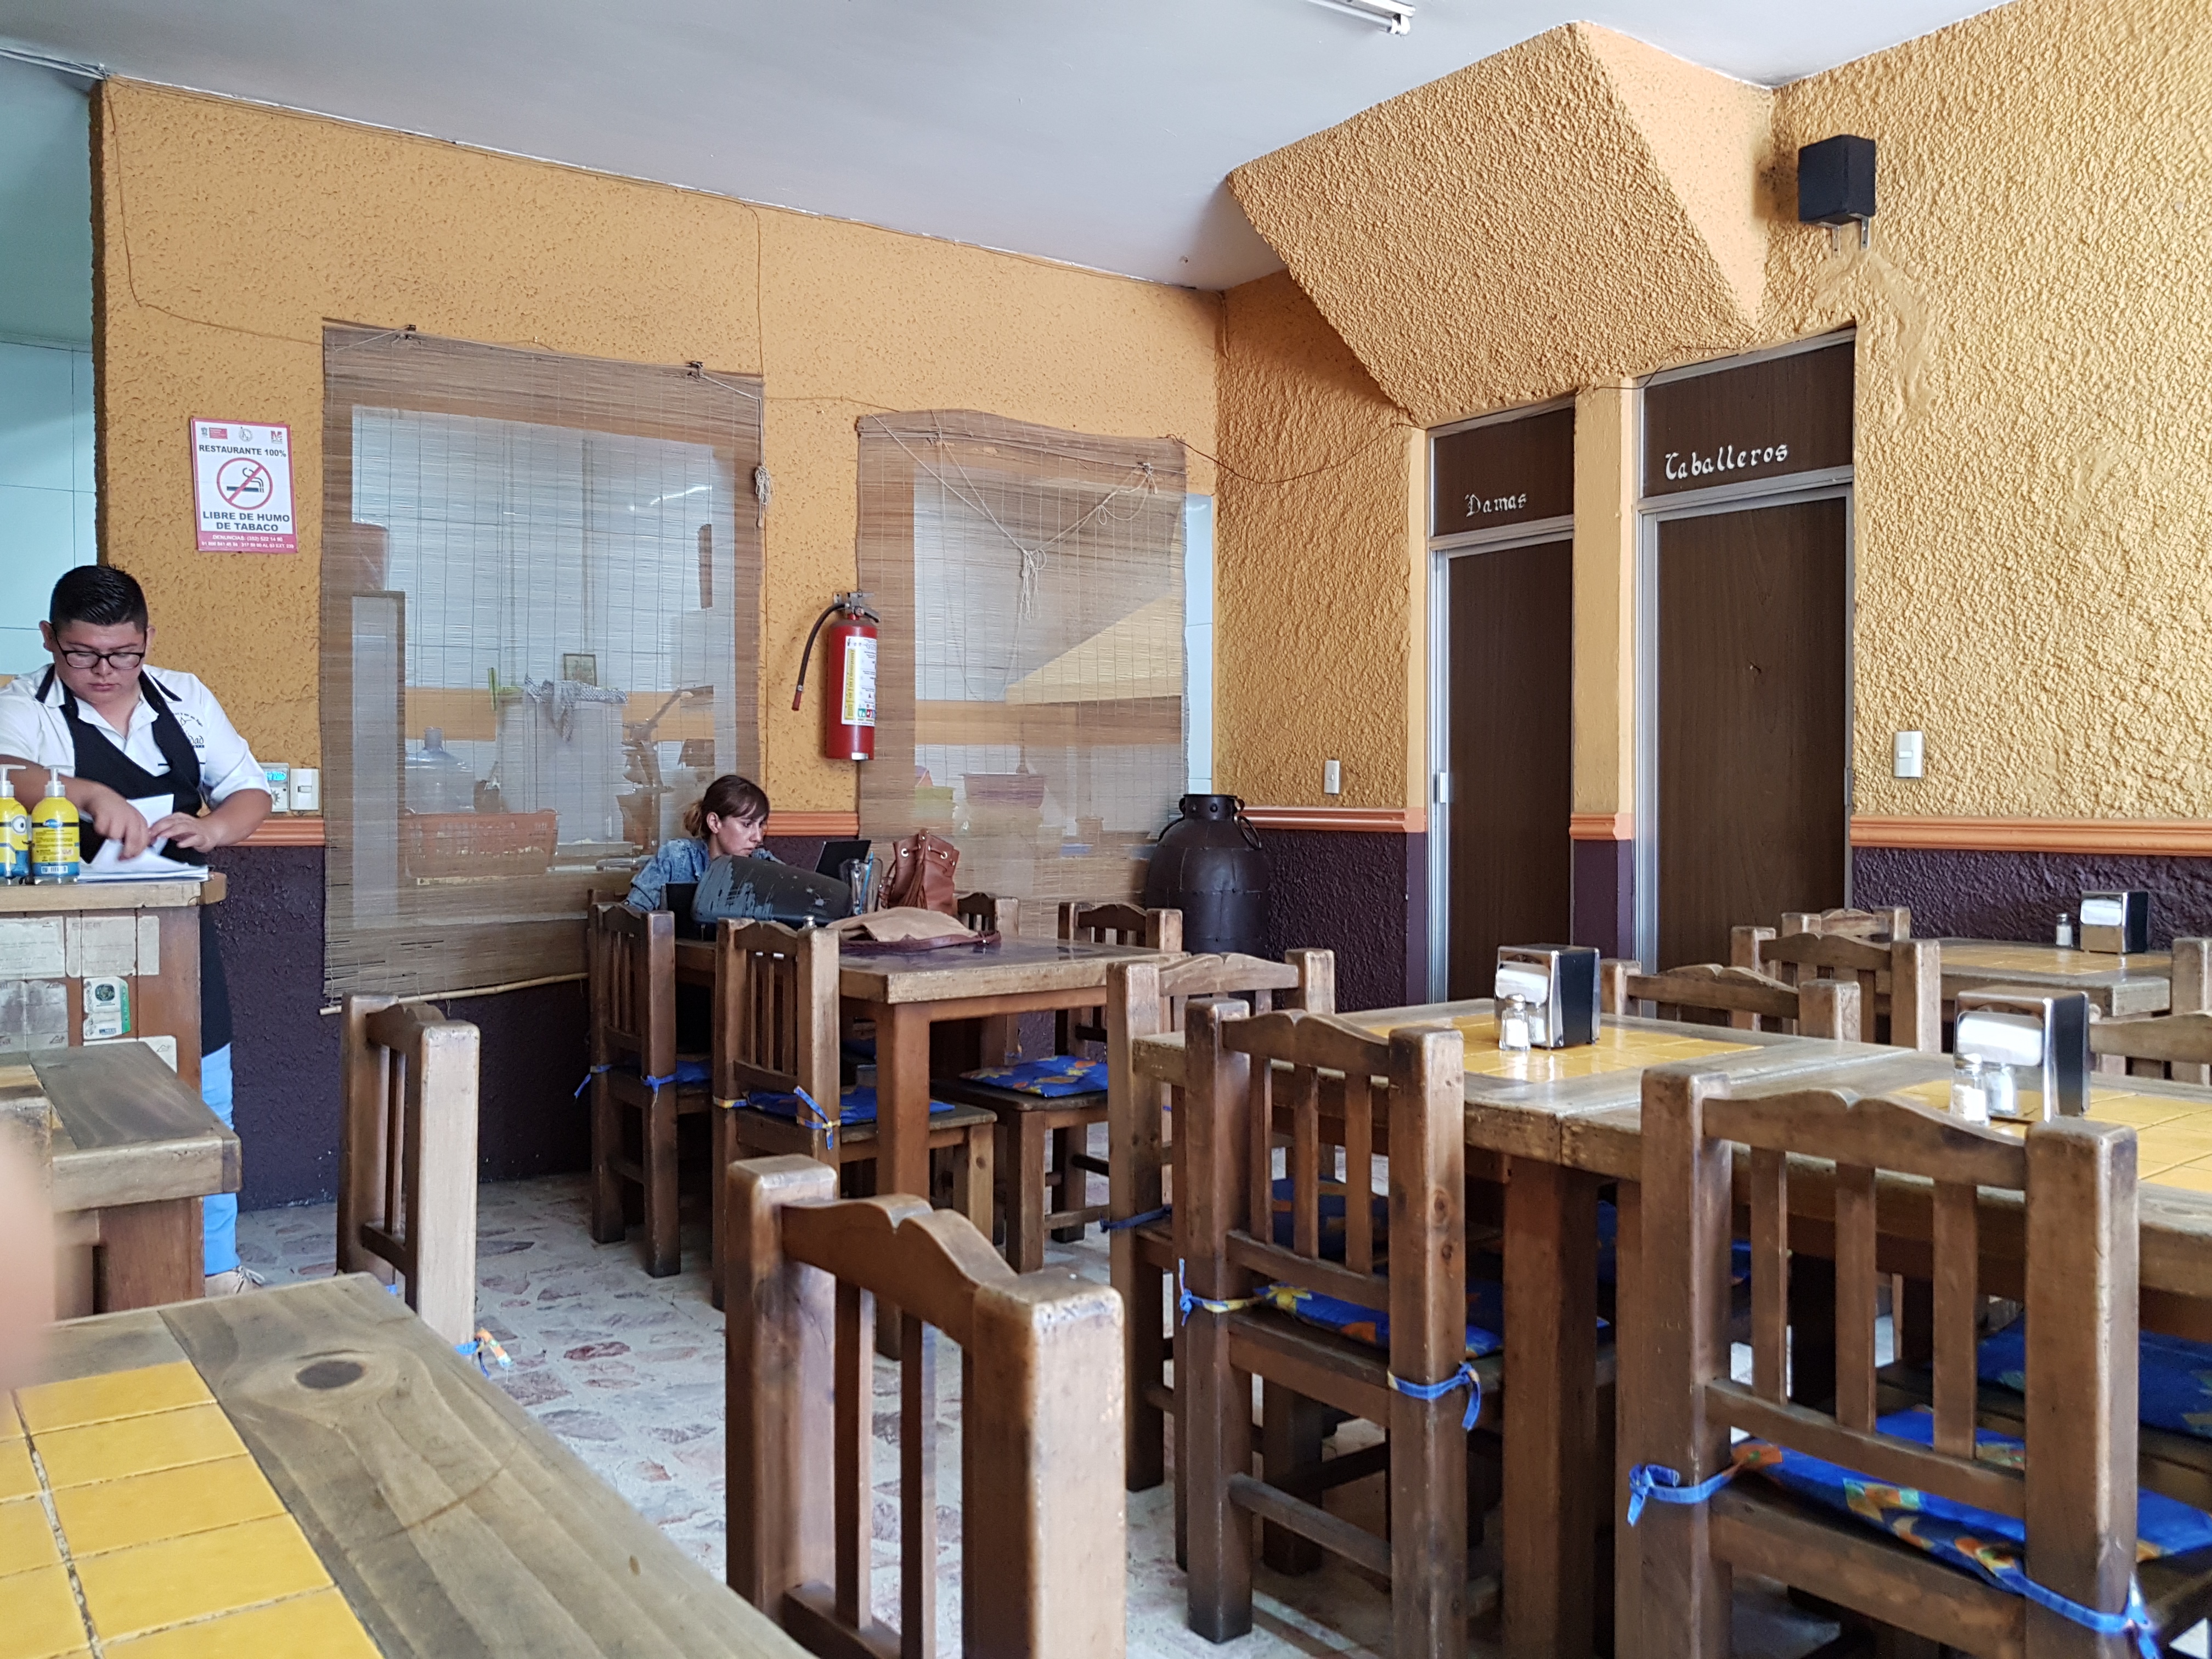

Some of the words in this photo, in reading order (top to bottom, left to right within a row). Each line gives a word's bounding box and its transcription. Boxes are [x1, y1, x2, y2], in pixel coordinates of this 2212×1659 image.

[199, 444, 262, 455] RESTAURANTE
[264, 449, 287, 458] 100%
[1664, 443, 1788, 480] Caballeros
[1464, 493, 1527, 518] Damas
[202, 511, 236, 520] LIBRE
[239, 512, 254, 521] DE
[257, 514, 290, 522] HUMO
[216, 522, 231, 530] DE
[234, 522, 279, 532] TABACO
